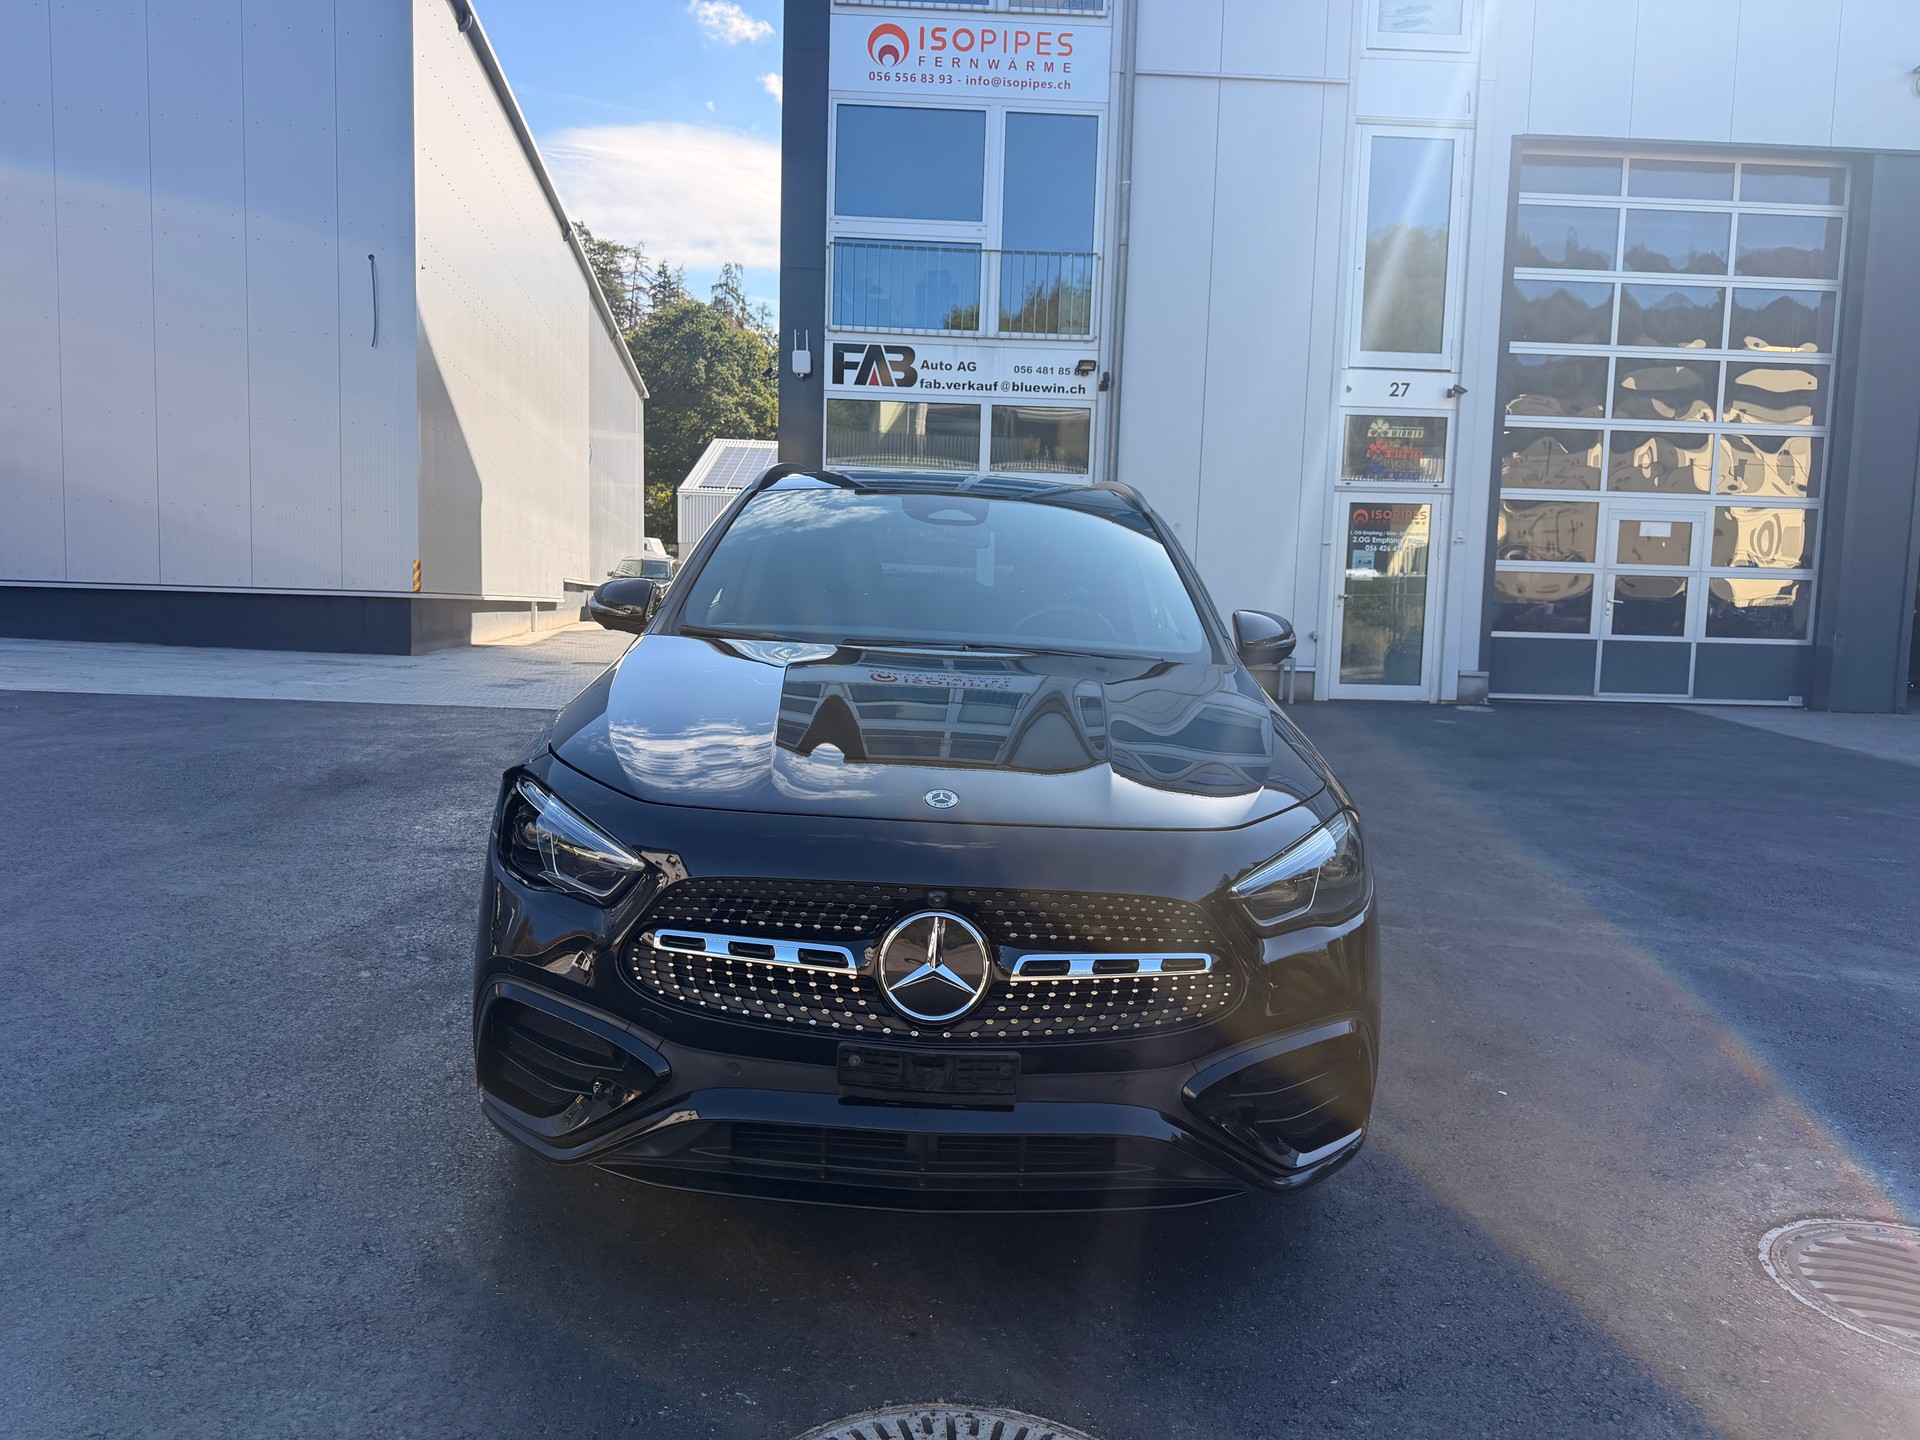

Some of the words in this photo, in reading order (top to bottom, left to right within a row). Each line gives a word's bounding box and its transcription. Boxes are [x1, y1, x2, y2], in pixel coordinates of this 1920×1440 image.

[919, 26, 1074, 57] ISOPIPES
[918, 55, 1072, 74] FERNWÄRME
[868, 70, 891, 82] 056
[894, 72, 917, 83] 556
[920, 73, 935, 84] 83
[938, 74, 953, 85] 93
[965, 75, 1071, 91] info@isopipes.ch
[832, 342, 918, 387] FAB
[920, 359, 953, 372] Auto
[956, 361, 977, 372] AG
[1013, 365, 1033, 375] 056
[1035, 366, 1054, 375] 481
[1057, 367, 1071, 376] 85
[919, 378, 1086, 395] fab.verkauf@bluewin.ch
[1388, 381, 1411, 398] 27
[1371, 509, 1427, 520] ISOPIPES
